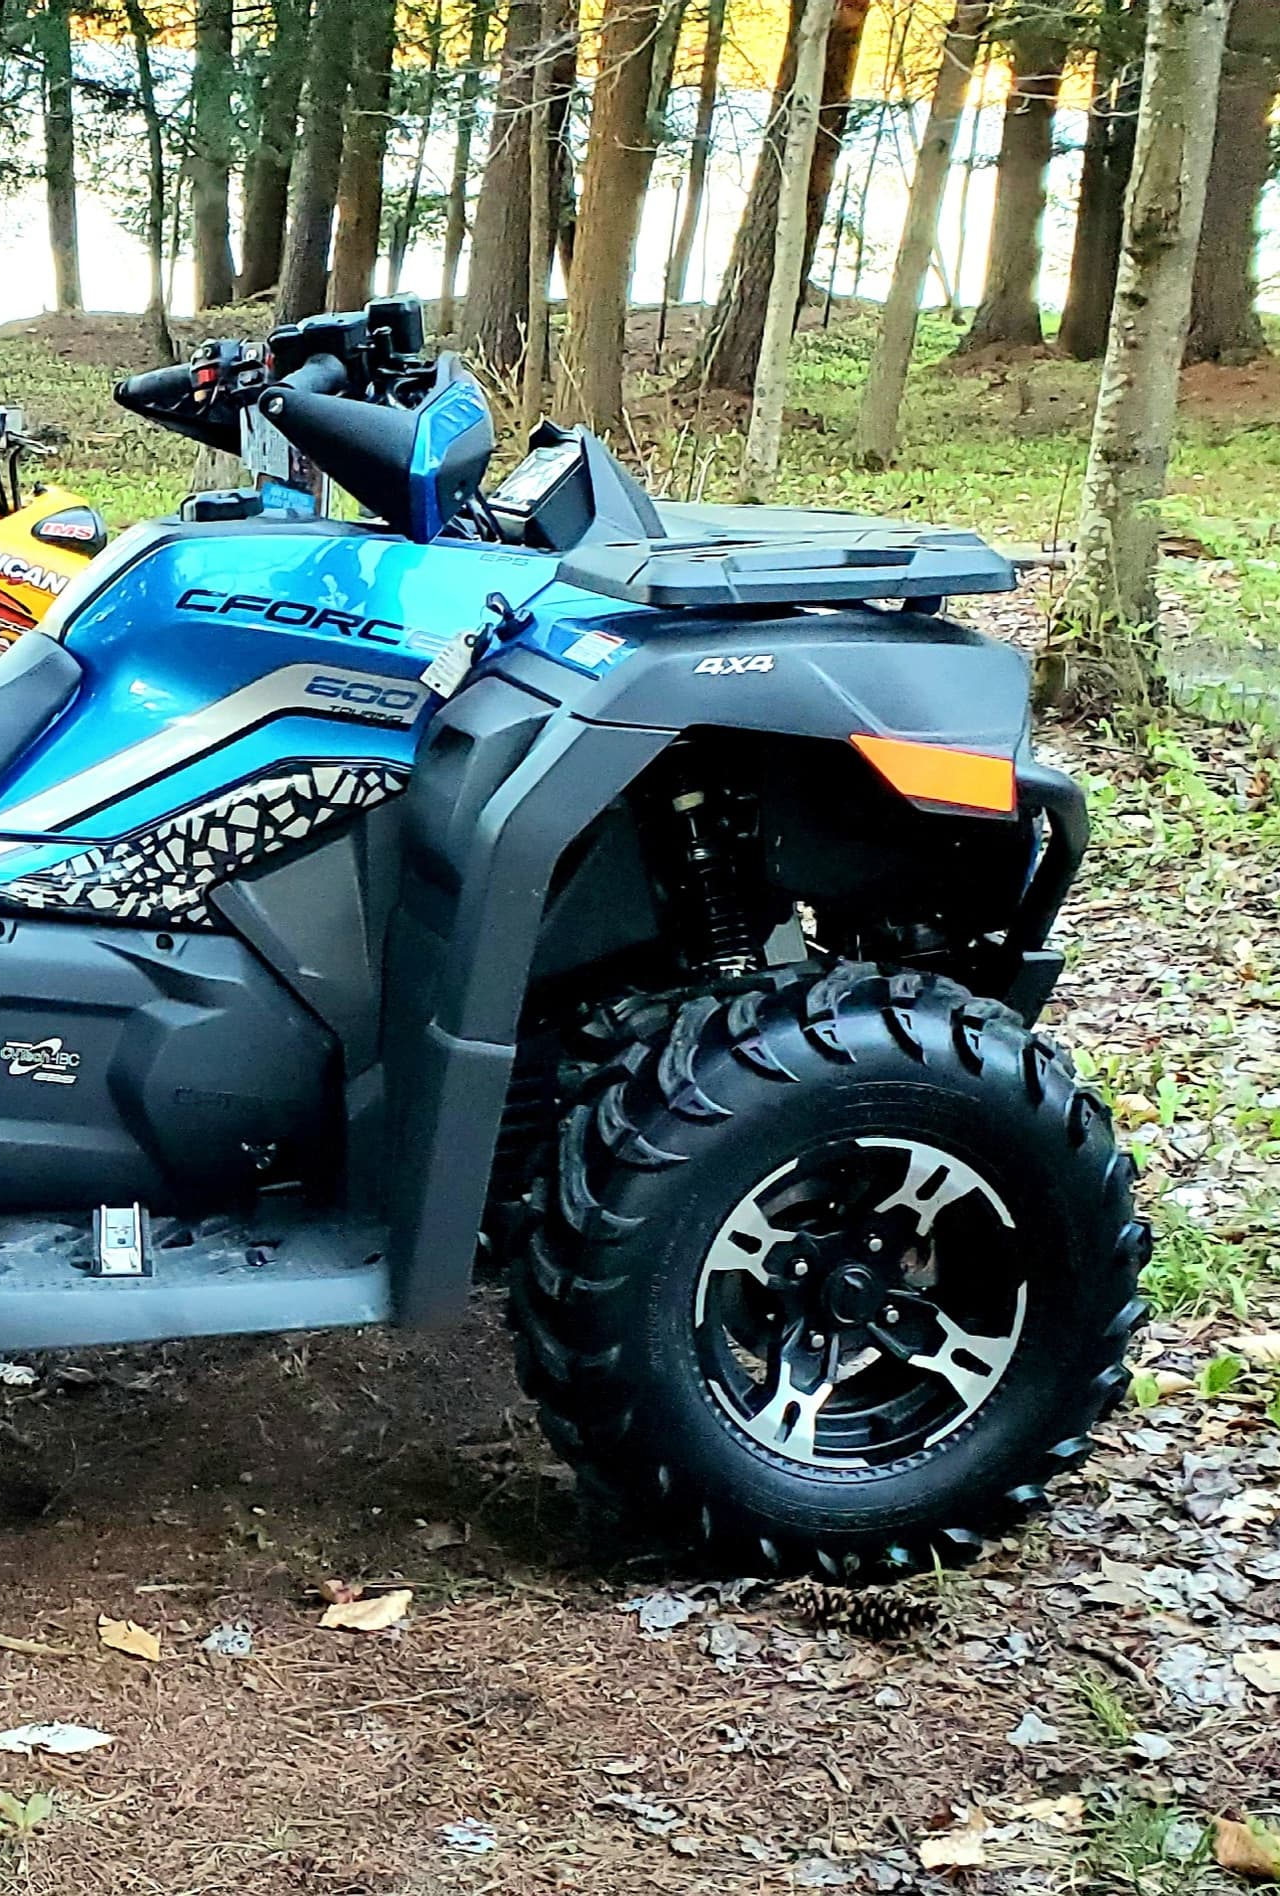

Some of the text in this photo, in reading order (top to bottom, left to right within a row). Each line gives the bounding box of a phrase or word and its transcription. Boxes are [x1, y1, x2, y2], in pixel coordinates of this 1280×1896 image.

[40, 522, 95, 540] IMS
[480, 553, 529, 566] EPS
[175, 588, 458, 652] CFORCE
[304, 675, 418, 710] 600
